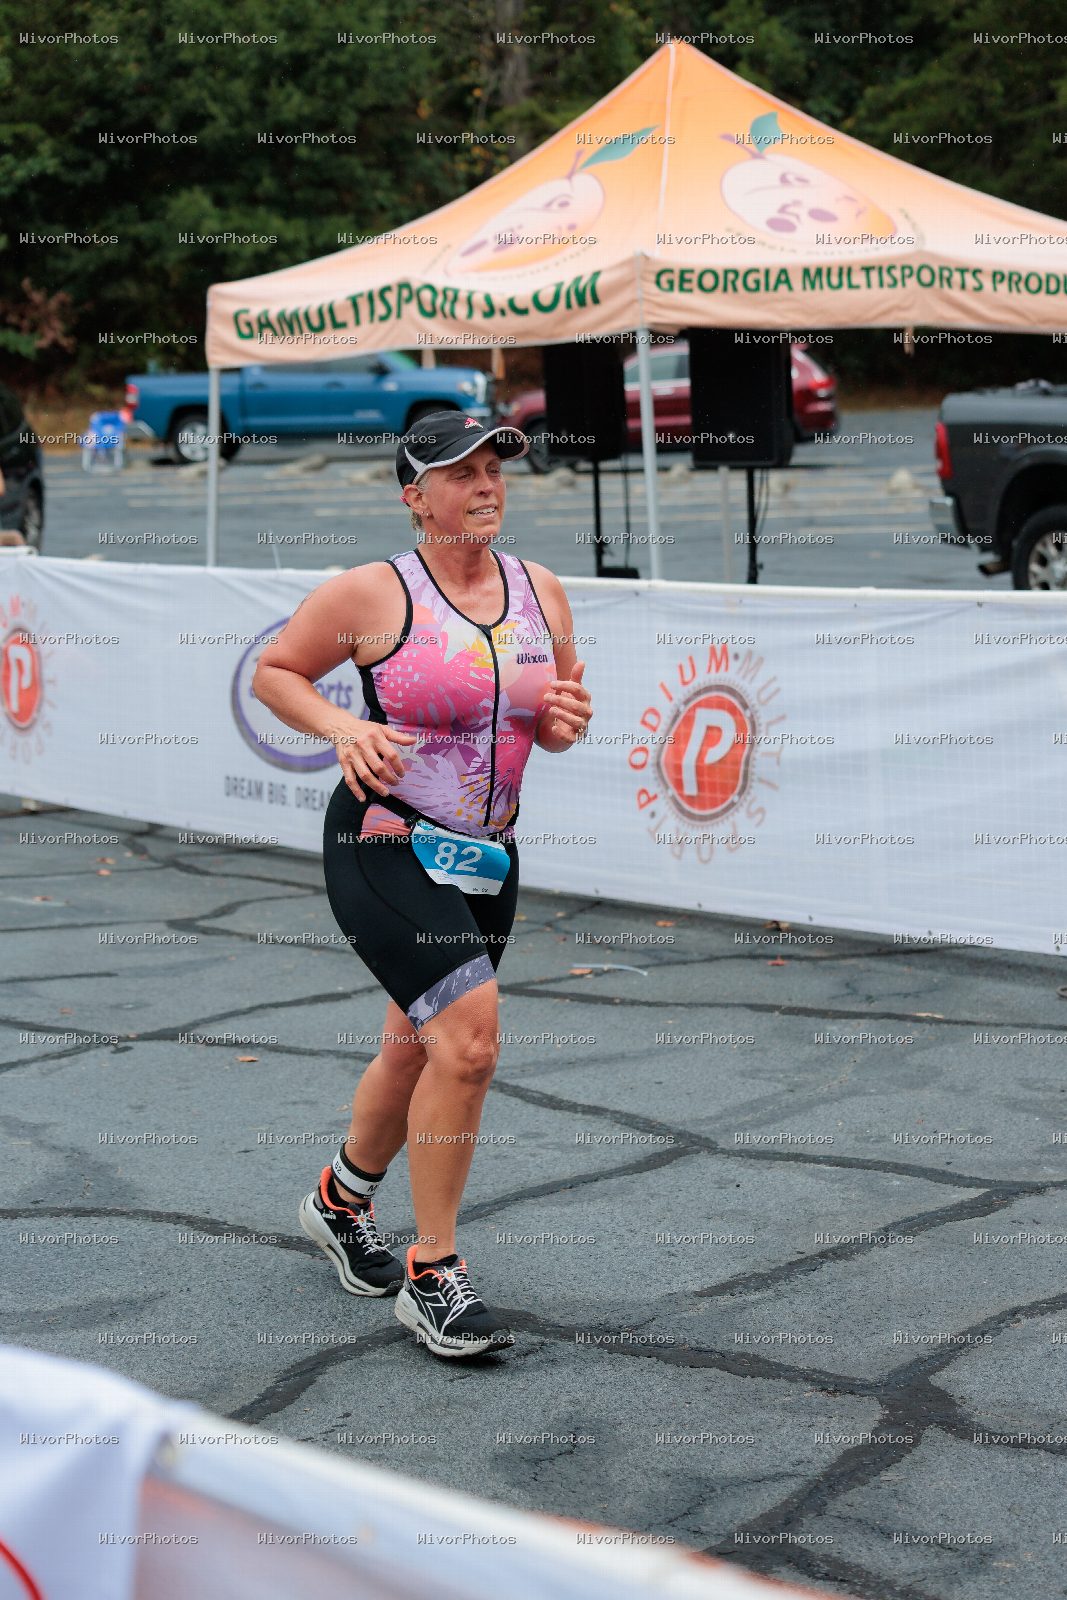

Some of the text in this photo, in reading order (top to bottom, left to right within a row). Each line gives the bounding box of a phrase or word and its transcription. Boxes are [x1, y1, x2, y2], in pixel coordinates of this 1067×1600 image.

[655, 266, 793, 293] GEORGIA
[801, 263, 984, 292] MULTISPORTS
[516, 652, 548, 665] Wixen
[628, 643, 730, 811] PODIUM
[682, 707, 737, 797] P
[224, 775, 264, 803] DREAM
[434, 841, 483, 873] 82
